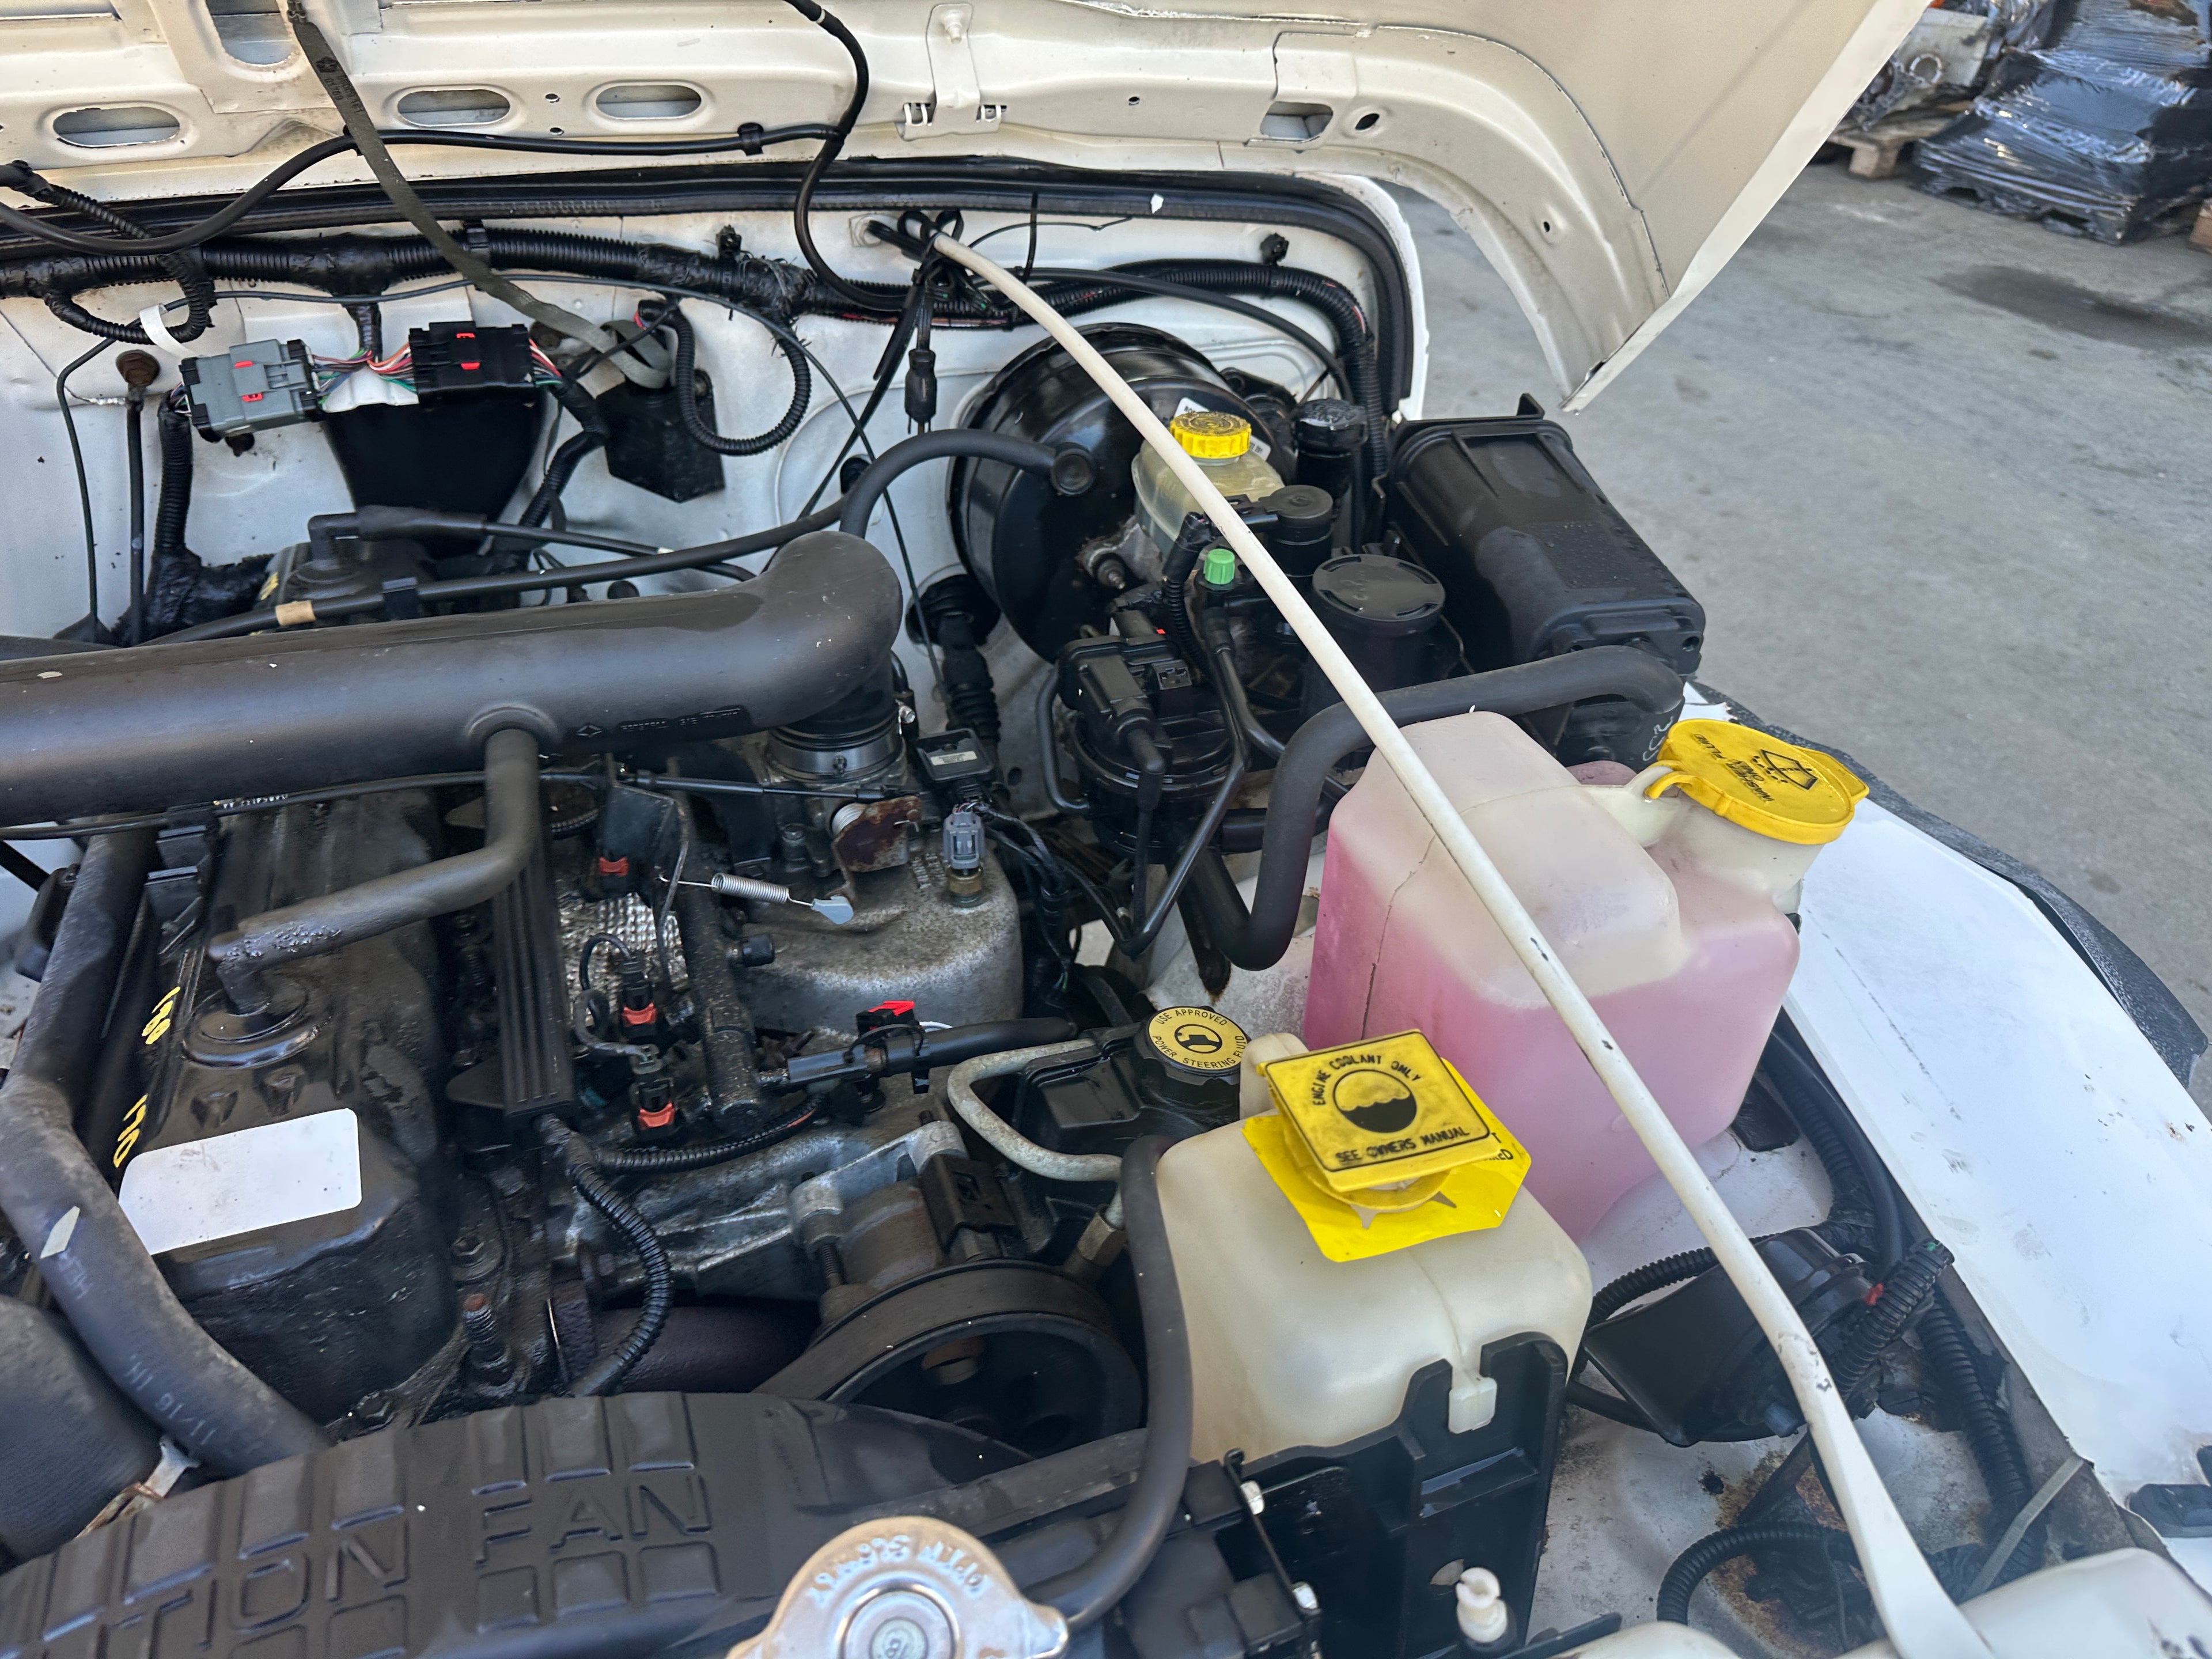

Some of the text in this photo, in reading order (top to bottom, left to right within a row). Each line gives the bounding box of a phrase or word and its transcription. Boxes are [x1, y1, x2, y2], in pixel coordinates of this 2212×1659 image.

[1694, 733, 1775, 802] WASHER FLUID
[1733, 759, 1765, 782] ONLY
[1155, 1009, 1228, 1025] USE APPROVED
[1152, 1035, 1246, 1069] POWER STEERING FLUID
[1312, 1055, 1421, 1105] ENGINE COOLANT ONLY
[1335, 1150, 1363, 1163] SEE
[1366, 1138, 1416, 1158] OWNERS
[1420, 1126, 1470, 1146] MANUAL
[475, 1474, 712, 1566] FAN
